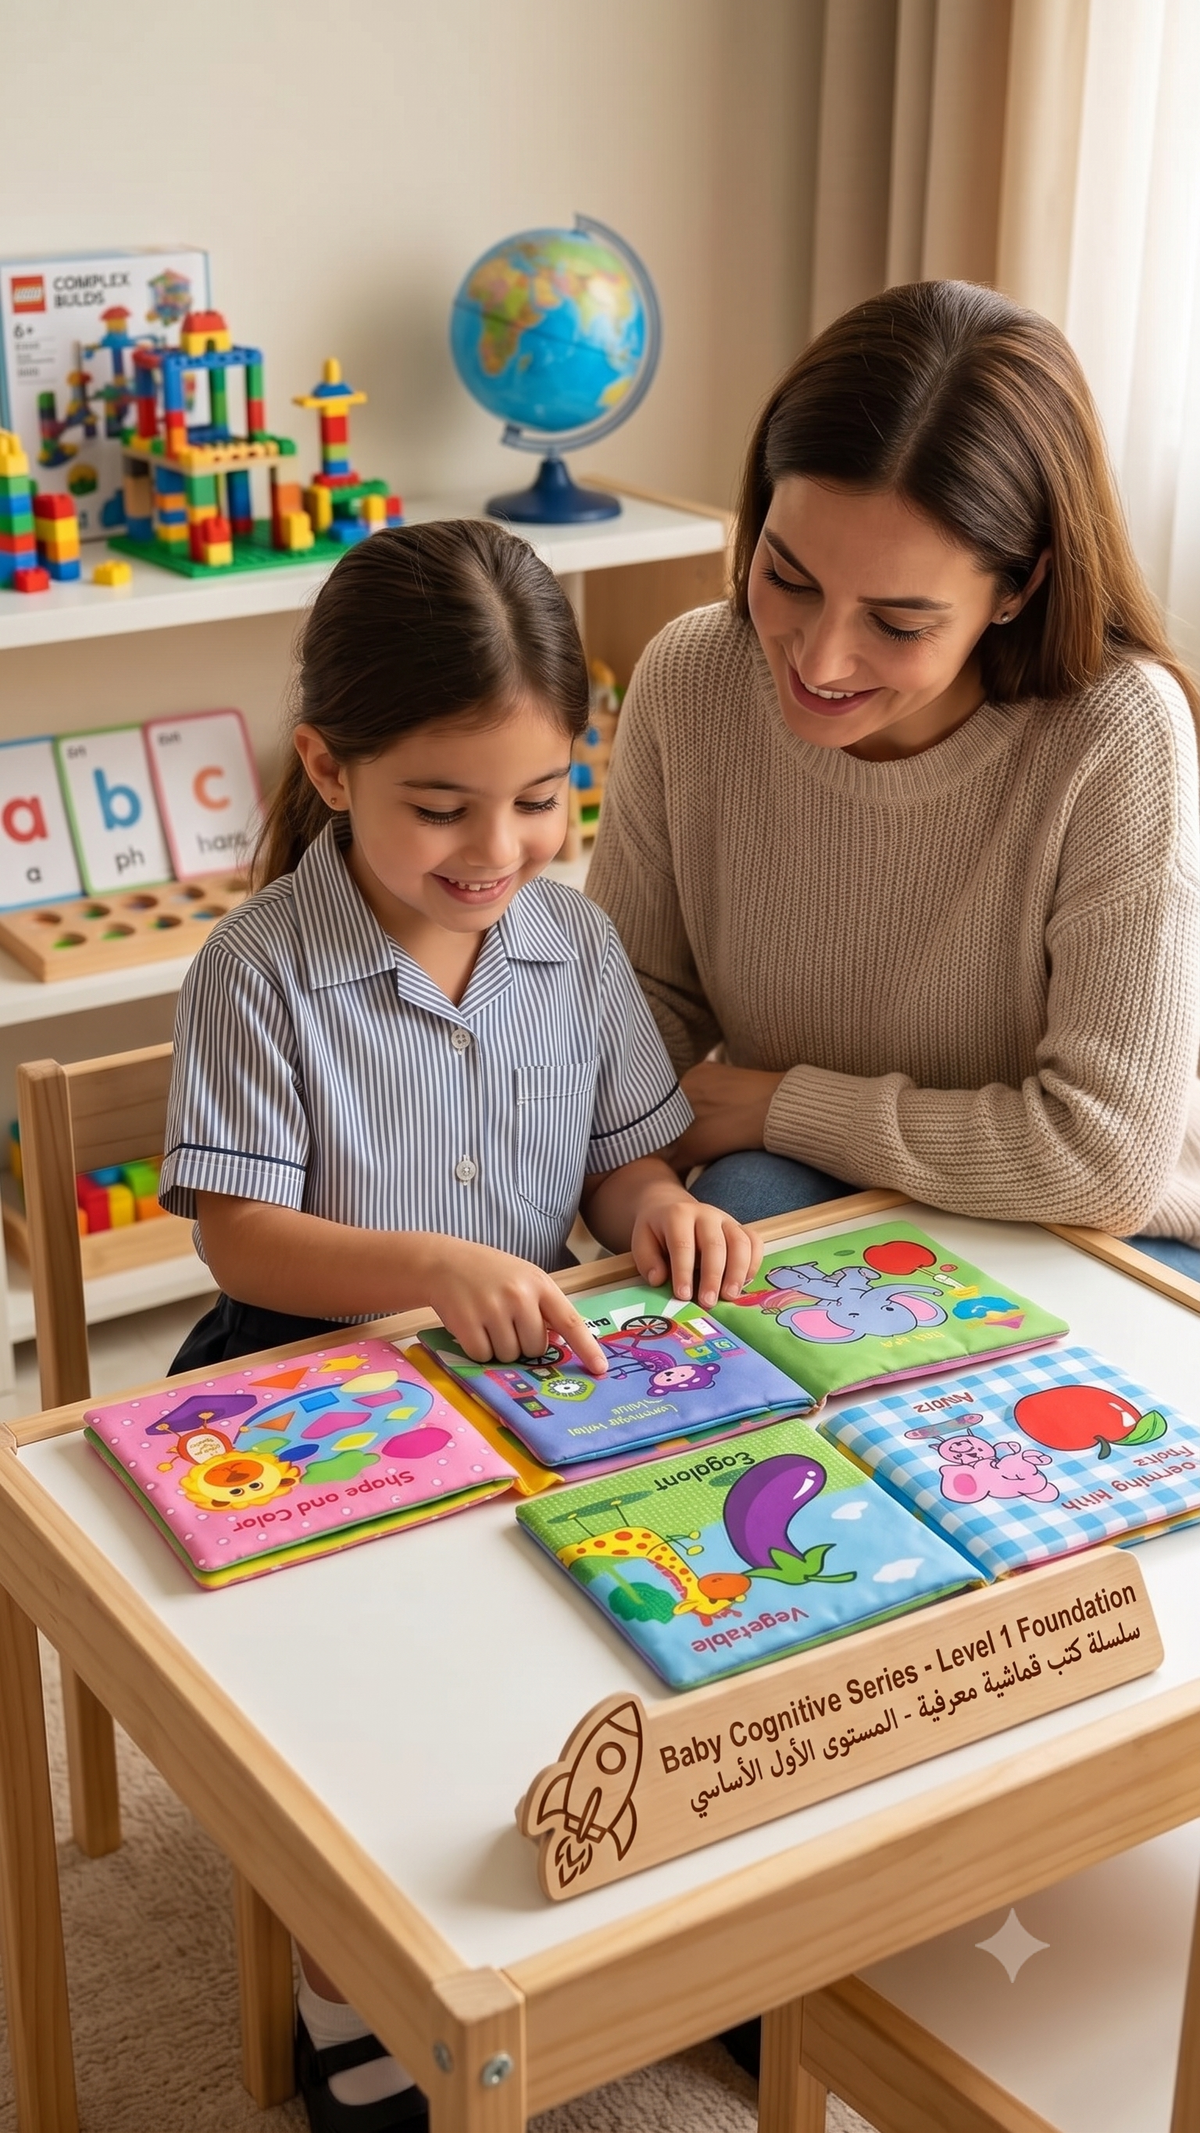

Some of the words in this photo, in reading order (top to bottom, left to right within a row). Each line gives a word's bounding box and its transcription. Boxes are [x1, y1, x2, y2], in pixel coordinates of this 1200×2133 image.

[93, 767, 142, 830] b
[192, 766, 230, 811] c
[2, 796, 48, 842] a
[26, 867, 42, 883] a
[345, 1471, 415, 1496] Shape
[233, 1509, 293, 1532] Color
[691, 1607, 809, 1653] Vegetable
[1086, 1622, 1141, 1654] سلسلة
[982, 1654, 1042, 1698] قماشية
[1047, 1637, 1082, 1675] كتب
[659, 1734, 722, 1774] Baby
[729, 1693, 842, 1747] Cognitive
[846, 1665, 919, 1705] Series
[936, 1630, 996, 1672] Level
[1000, 1624, 1013, 1648] 1
[1016, 1584, 1137, 1643] Foundation
[917, 1687, 978, 1722] معرفية
[822, 1708, 899, 1760] المستوى
[770, 1738, 816, 1777] الأول
[690, 1757, 763, 1818] الأساسي
